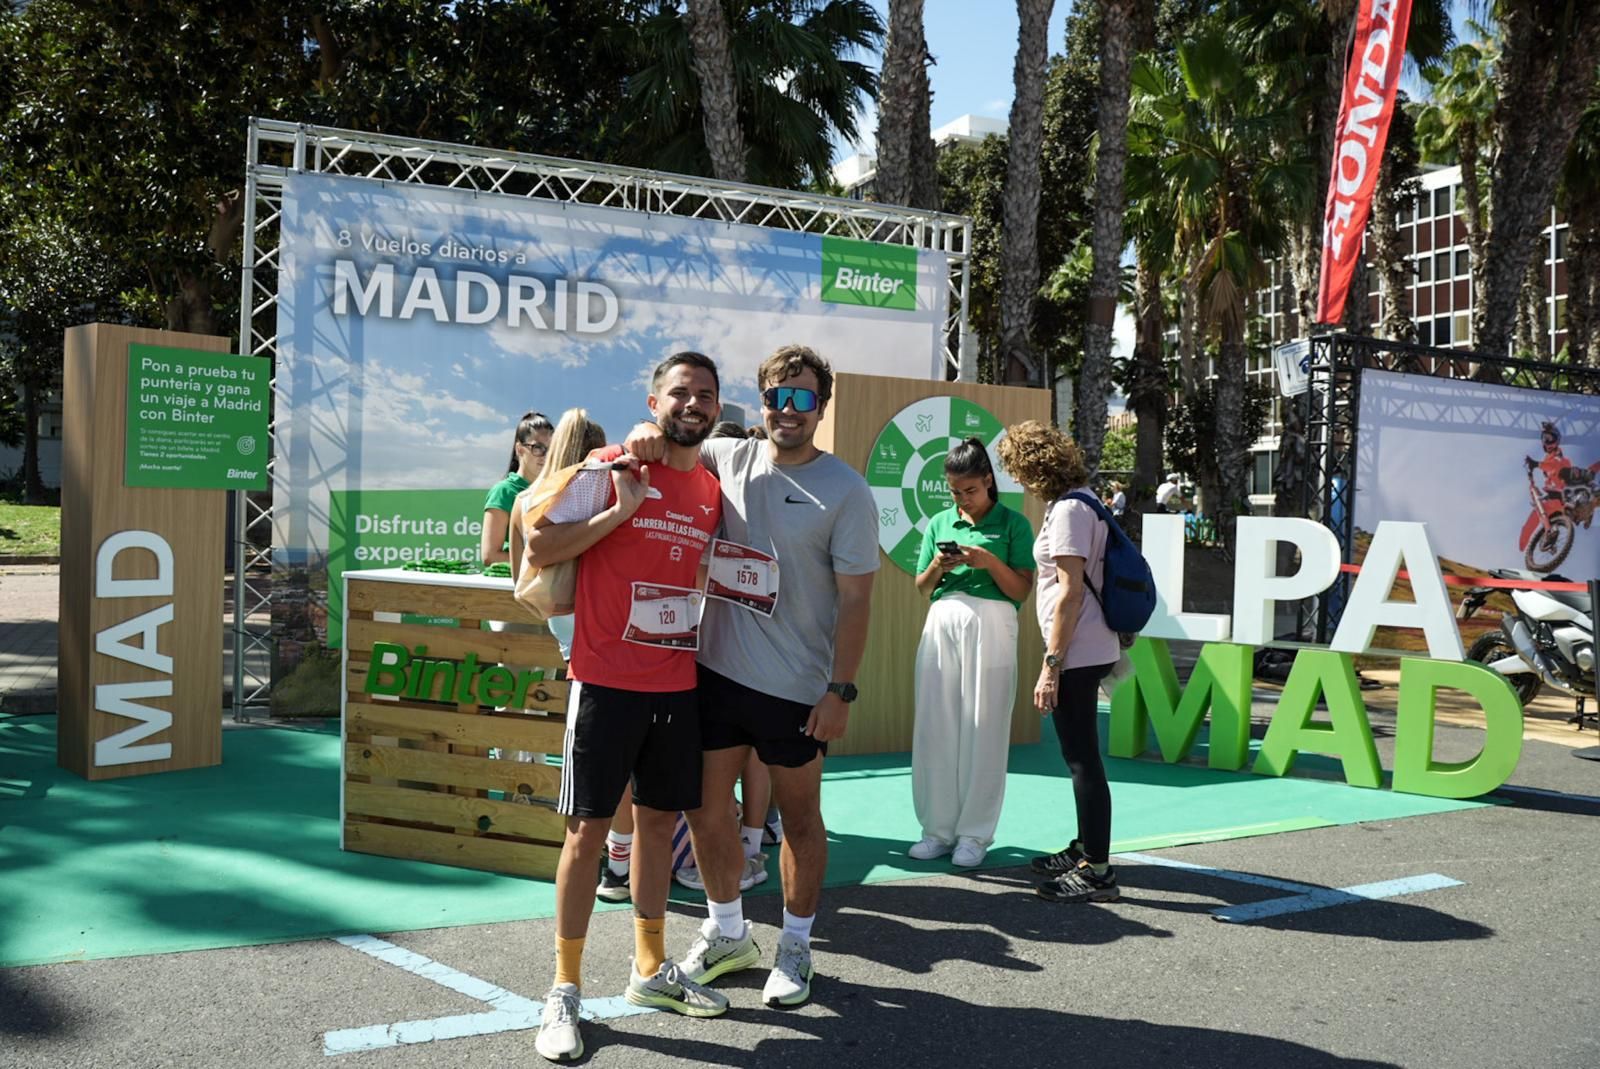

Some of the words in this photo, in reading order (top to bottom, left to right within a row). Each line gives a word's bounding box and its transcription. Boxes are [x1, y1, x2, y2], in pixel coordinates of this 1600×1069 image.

[337, 229, 352, 248] 8
[360, 231, 431, 256] Vuelos
[439, 240, 508, 263] diarios
[515, 252, 527, 266] a
[835, 266, 904, 295] Binter
[333, 259, 619, 334] MADRID
[141, 357, 170, 373] Pon
[175, 364, 183, 374] a
[188, 365, 237, 379] prueba
[241, 368, 255, 380] tu
[141, 377, 201, 391] puntería
[205, 383, 213, 395] y
[217, 384, 251, 397] gana
[140, 393, 159, 404] un
[163, 393, 196, 409] viaje
[201, 398, 209, 408] a
[214, 396, 261, 412] Madrid
[140, 409, 166, 420] con
[172, 408, 214, 423] Binter
[226, 468, 258, 479] Binter
[355, 514, 448, 536] Disfruta
[453, 516, 482, 536] de
[632, 517, 667, 531] CARRERA
[667, 522, 676, 533] DE
[676, 524, 688, 535] LAS
[736, 570, 758, 586] 1578
[1138, 513, 1465, 662] LPA
[659, 610, 676, 625] 120
[94, 529, 175, 766] MAD
[364, 641, 545, 709] Binter
[1108, 636, 1524, 799] MAD
